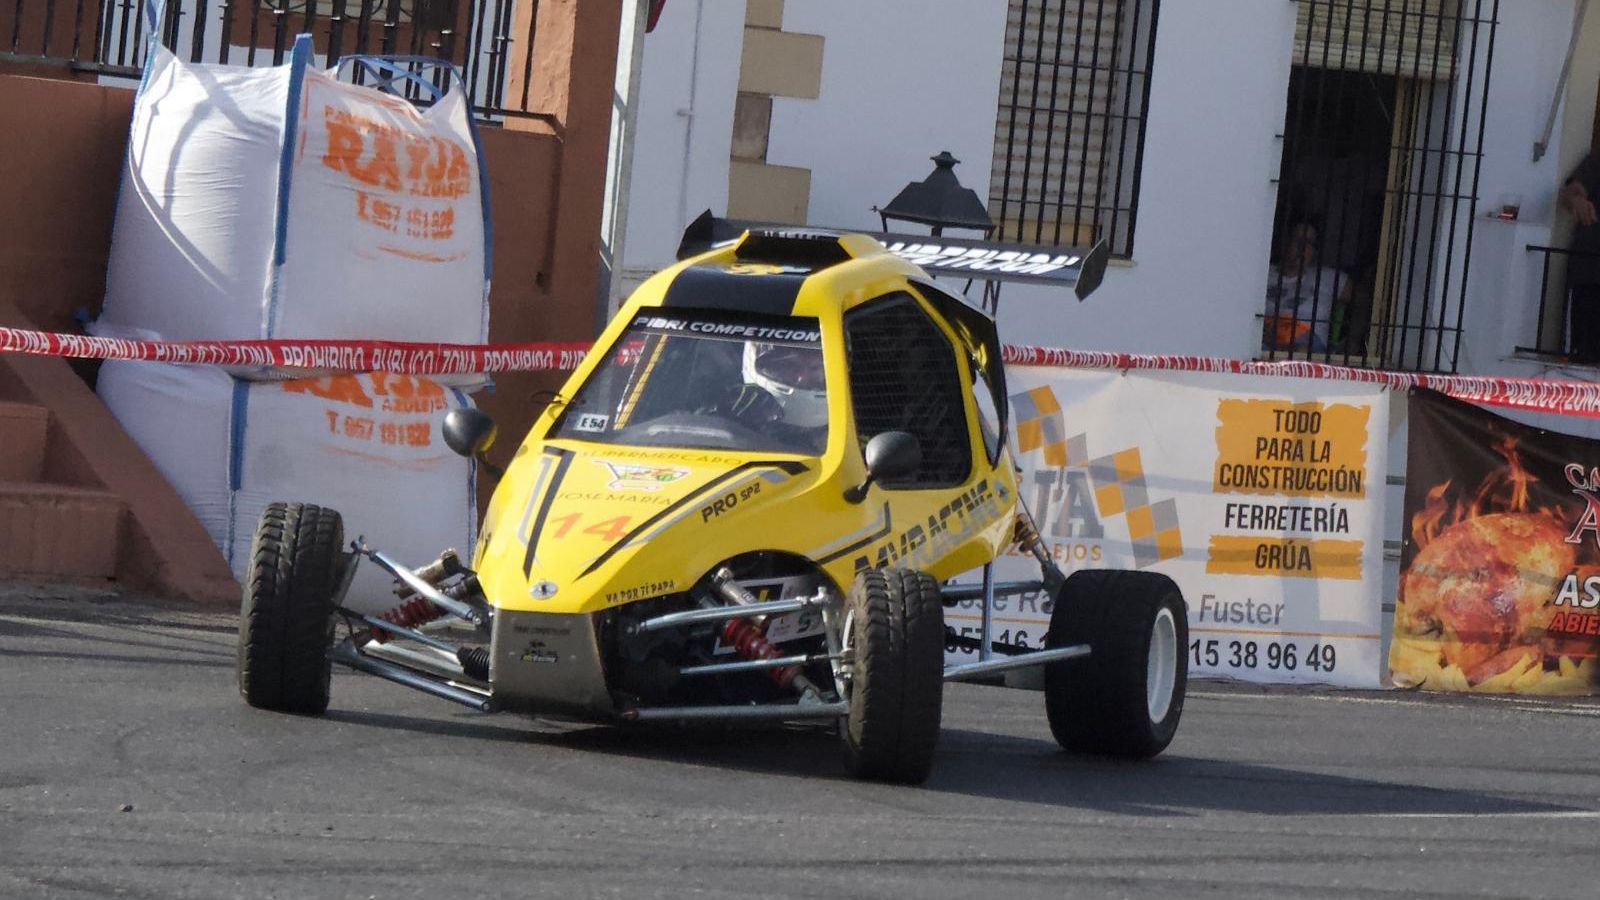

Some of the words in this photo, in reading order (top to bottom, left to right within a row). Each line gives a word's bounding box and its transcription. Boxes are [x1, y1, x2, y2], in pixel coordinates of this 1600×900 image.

[689, 321, 821, 342] COMPETICION
[1273, 408, 1322, 434] TODO
[1256, 436, 1304, 462] PARA
[1310, 440, 1331, 463] LA
[1219, 463, 1362, 493] CONSTRUCCIÓN
[701, 492, 737, 523] PRO
[740, 482, 760, 501] SP2
[551, 512, 633, 541] 14
[1224, 503, 1349, 534] FERRETERÍA
[1254, 540, 1312, 571] GRÚA
[1554, 573, 1600, 608] AS
[1199, 593, 1285, 625] Fuster
[1228, 640, 1258, 668] 38
[1267, 642, 1297, 670] 96
[1305, 644, 1336, 672] 49
